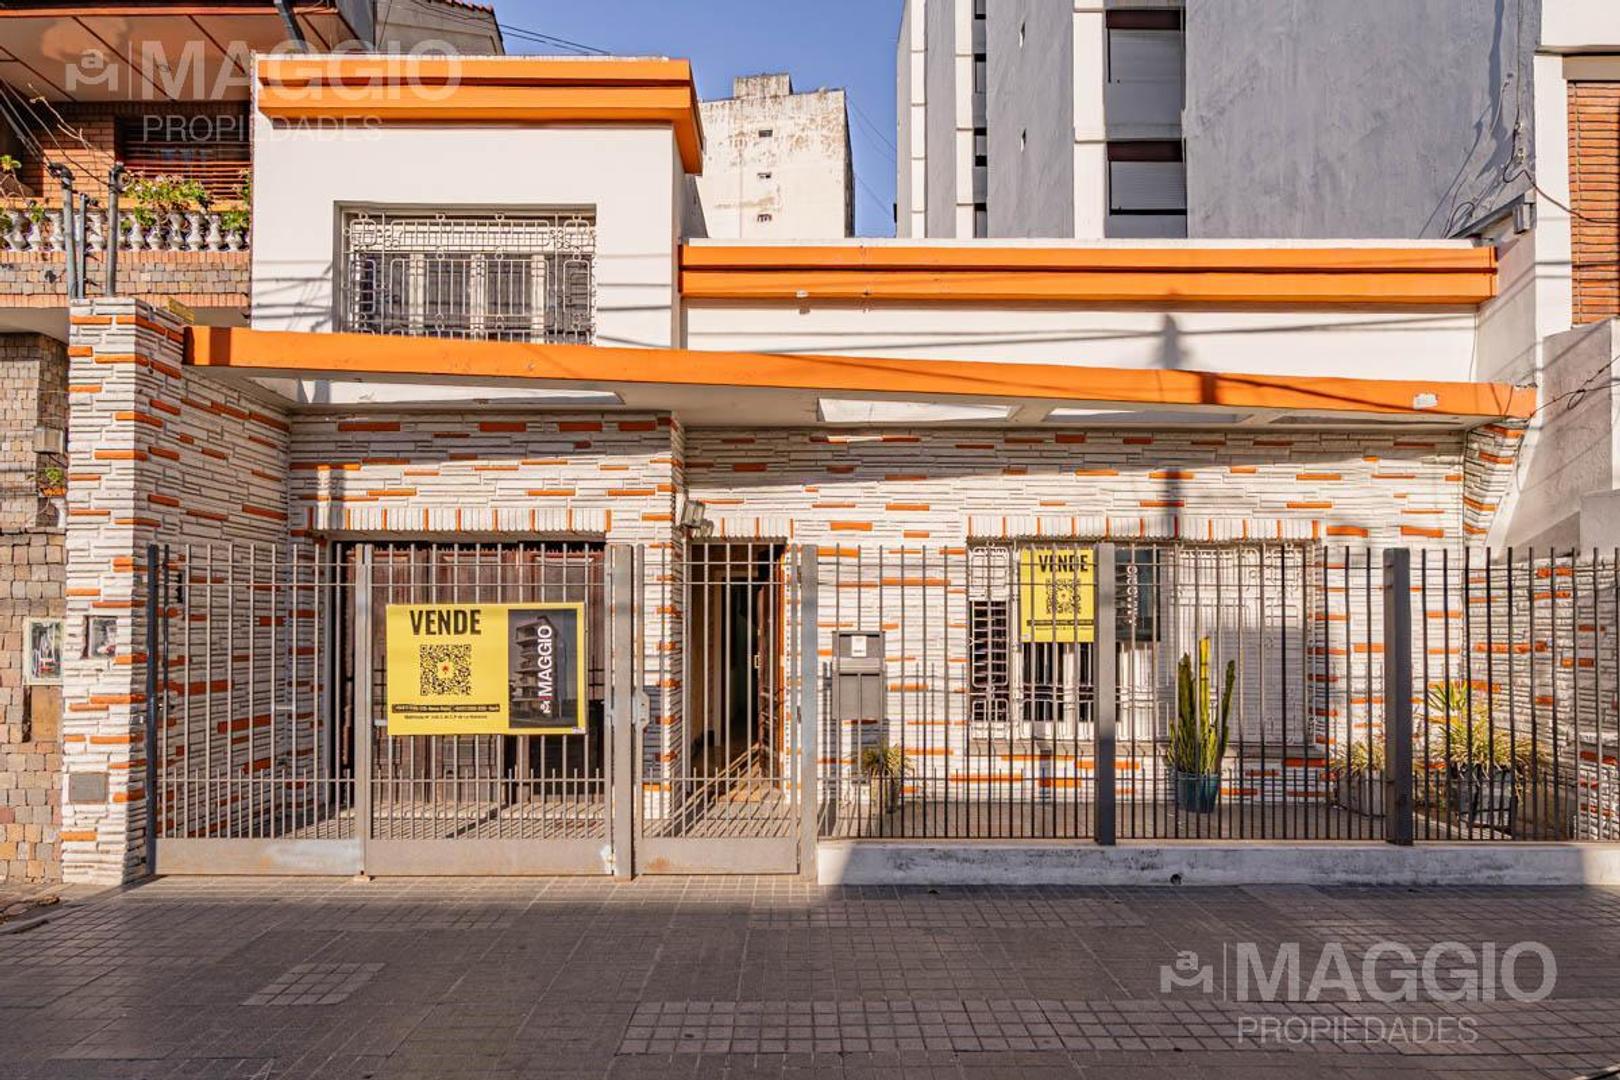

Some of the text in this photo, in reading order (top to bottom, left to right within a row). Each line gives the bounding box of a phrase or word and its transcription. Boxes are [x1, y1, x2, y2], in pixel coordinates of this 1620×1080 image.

[1038, 554, 1089, 573] VENDE
[409, 609, 482, 636] VENDE
[537, 625, 552, 697] MAGGIO
